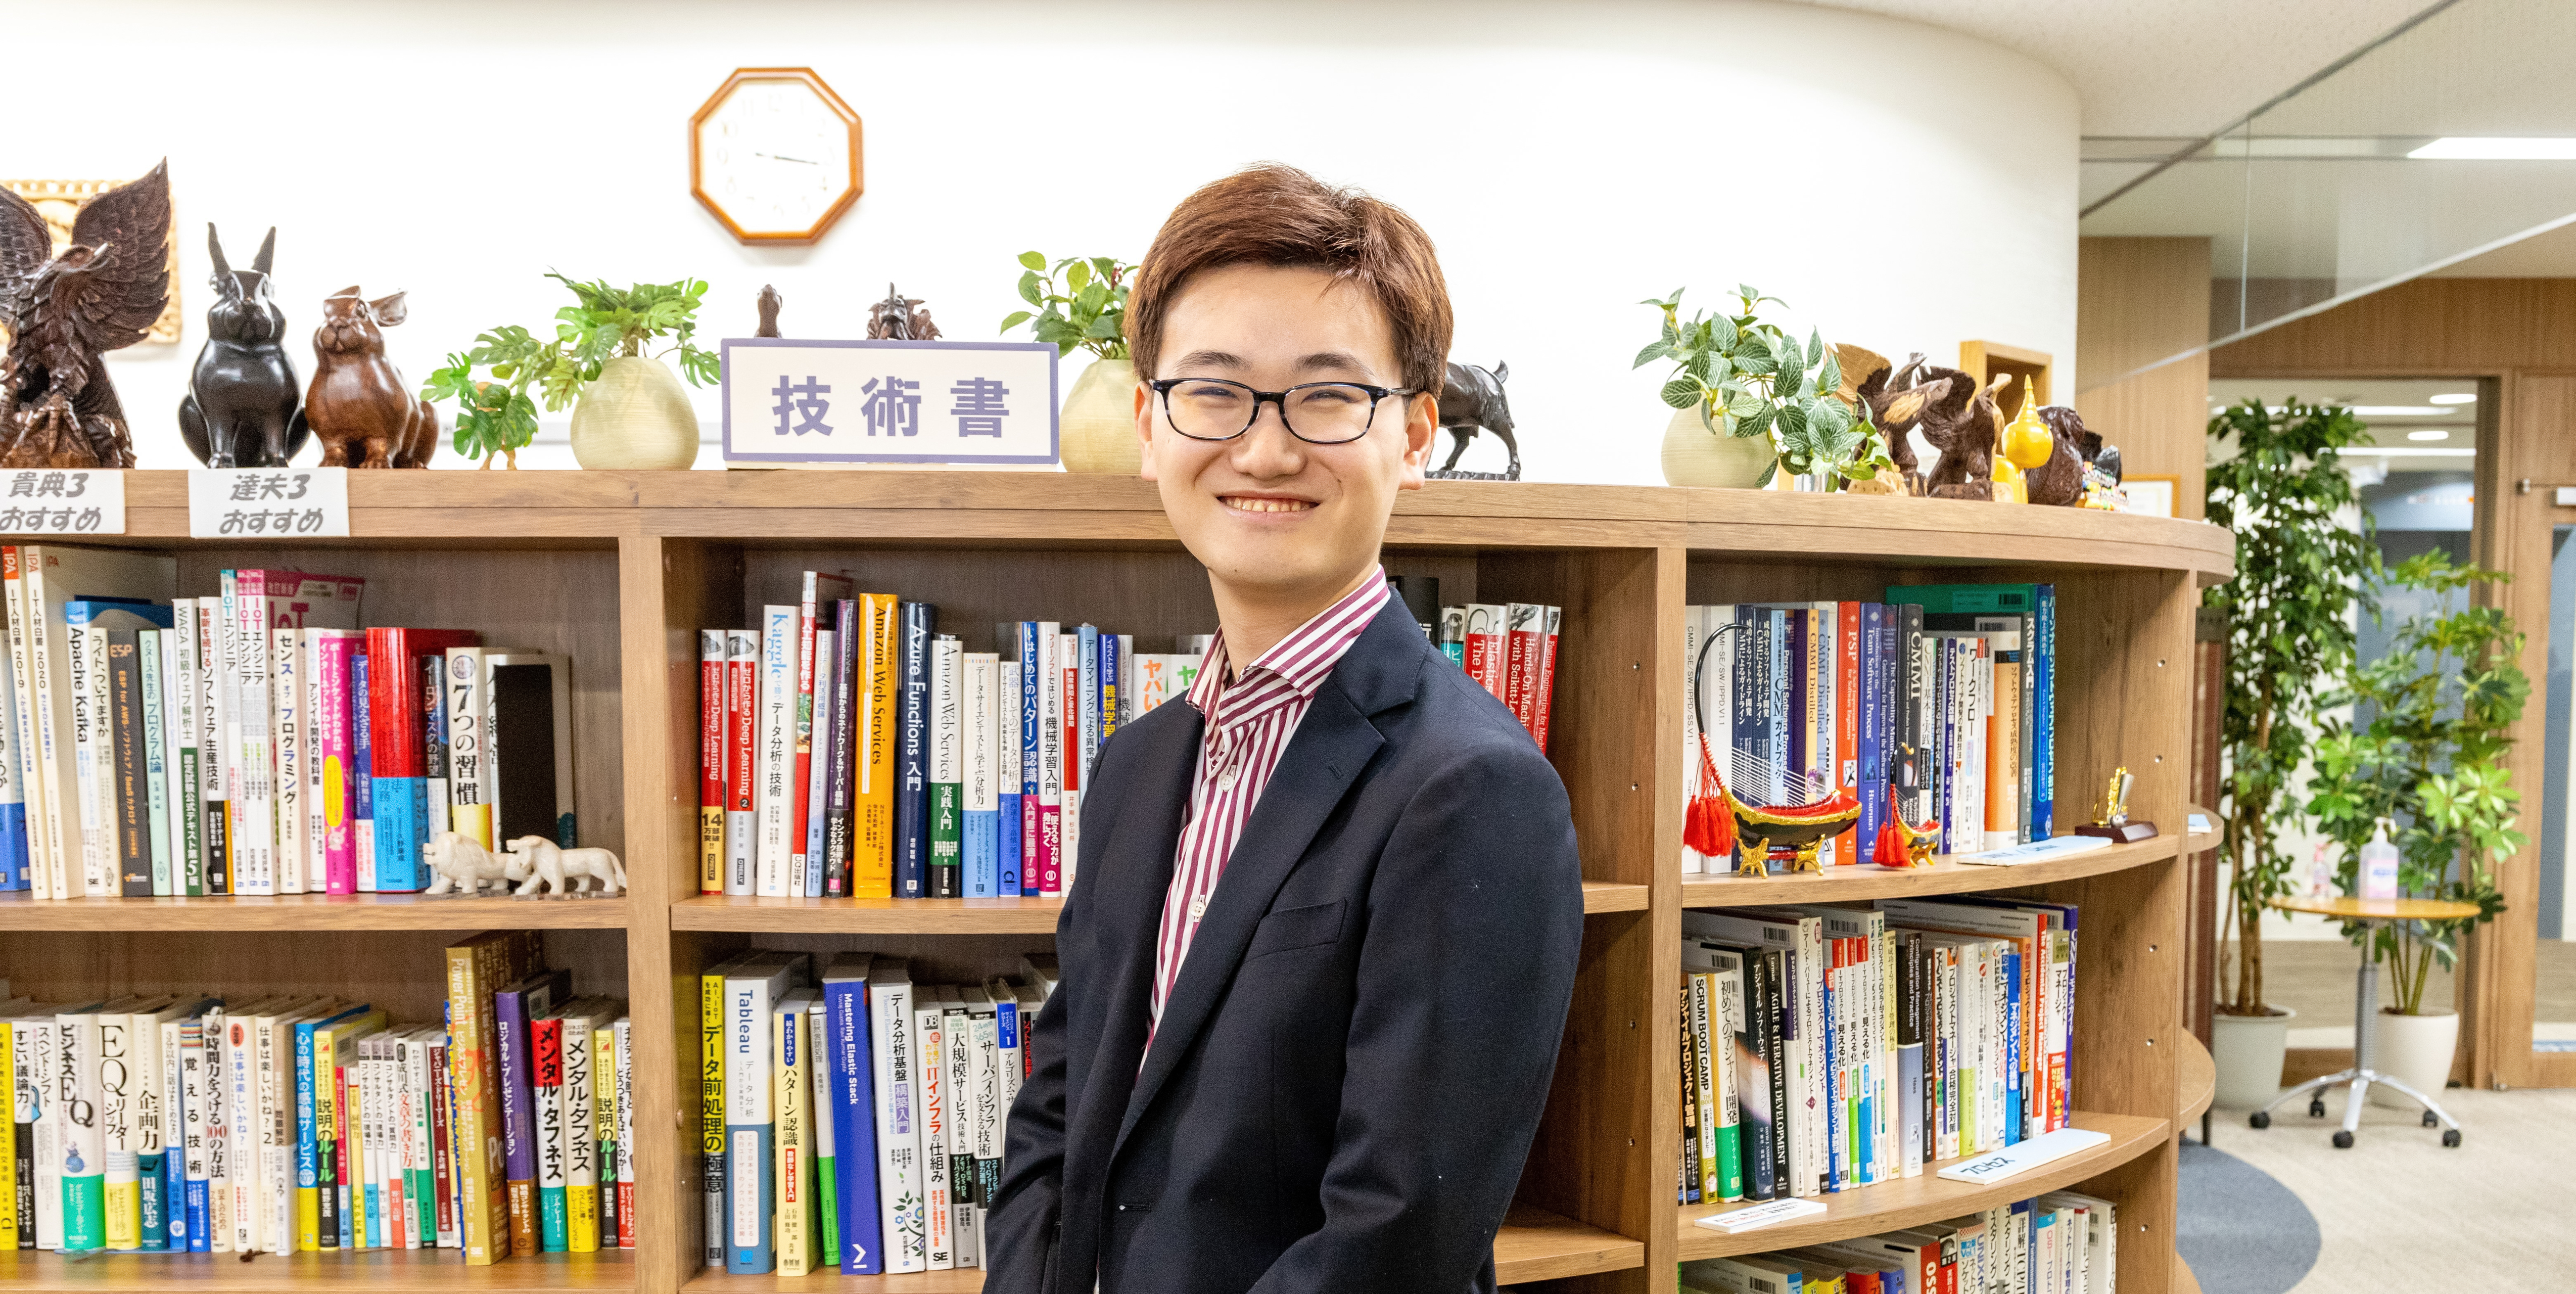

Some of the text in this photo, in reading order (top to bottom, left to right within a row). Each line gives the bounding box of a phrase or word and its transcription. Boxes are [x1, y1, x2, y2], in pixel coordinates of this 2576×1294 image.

[772, 375, 1009, 438] 技術書
[1, 506, 102, 531] おすすめ
[8, 473, 88, 497] 貴典3
[229, 474, 310, 500] 達夫3
[219, 509, 324, 533] おすすめ
[5, 553, 16, 573] IPA
[27, 554, 39, 573] IPA
[16, 652, 24, 688] 2019
[37, 652, 45, 688] 2020
[69, 628, 86, 690] Apache
[179, 607, 193, 740] WACA 初級ウェブ解析士
[767, 614, 788, 679] Kaggle
[801, 620, 813, 690] 人工知能を作る
[1472, 640, 1485, 667] The
[1522, 637, 1535, 687] Hands-On
[1545, 640, 1555, 670] Feature
[1848, 631, 1857, 661] PSP
[1865, 657, 1875, 701] Software
[1910, 631, 1922, 700] CMMI
[2026, 618, 2035, 688] スクラム入門
[358, 660, 370, 749] データの見えざる手
[872, 607, 886, 764] Amazon Web Services
[907, 624, 927, 791] Azure Functions 入門
[941, 645, 958, 780] Amazon Web Services
[1023, 642, 1037, 783] はじめてのパターン認識
[1103, 685, 1116, 737] 機械学習
[1143, 659, 1162, 712] ヤバい
[1541, 672, 1552, 711] Engineering
[1817, 634, 1826, 734] CMMI Distilled
[1968, 649, 1978, 736] ワークフロー
[76, 696, 87, 743] Kafka
[203, 668, 218, 791] ソフトウェア生産技術
[309, 683, 320, 785] アジャイル開発の教科書
[454, 684, 479, 805] 7つの習慣
[711, 706, 721, 732] Deep
[739, 667, 752, 795] ゼロから作る Deep Learning
[770, 703, 784, 797] データ分析の技術
[1008, 666, 1019, 793] 武器としてのデータ分析力
[709, 734, 720, 780] Learning
[1045, 716, 1057, 795] 機械学習入門
[701, 814, 722, 826] 14
[941, 785, 953, 830] 実践入門
[1025, 801, 1036, 866] 入門書に最適！
[1042, 812, 1051, 847] 身につく
[739, 990, 753, 1053] Tableau
[1696, 979, 1709, 1090] SCRUM BOOT CAMP
[1771, 992, 1779, 1023] AGILE
[99, 1025, 127, 1096] EQ
[844, 994, 859, 1104] Mastering Elastic Stack
[891, 993, 910, 1133] データ分析基盤 構築入門
[1680, 989, 1696, 1128] アジャイルプロジェクト管理
[1721, 981, 1738, 1124] 初めてのアジャイル開発
[1773, 1036, 1785, 1088] ITERATIVE
[105, 1103, 117, 1134] シップ
[138, 1090, 159, 1150] 企画力
[184, 1057, 202, 1174] 覚える技術
[233, 1050, 247, 1145] 仕事は楽しいかね？
[541, 1028, 562, 1180] メンタル・タフネス
[567, 1039, 591, 1171] メンタル・タフネス
[703, 1025, 724, 1192] データ前処理の極意
[745, 1060, 754, 1117] データ分析
[782, 1065, 798, 1146] パターン認識
[950, 1033, 966, 1152] 大規模サービス技術入門
[116, 1098, 127, 1150] リーダー
[316, 1099, 335, 1182] 説明のルール
[597, 1098, 616, 1182] 説明のルール
[927, 1068, 944, 1182] ITインフラの仕組み
[976, 1094, 991, 1156] を支える技術
[1775, 1090, 1786, 1165] DEVELOPMENT
[142, 1177, 158, 1228] 田坂広志
